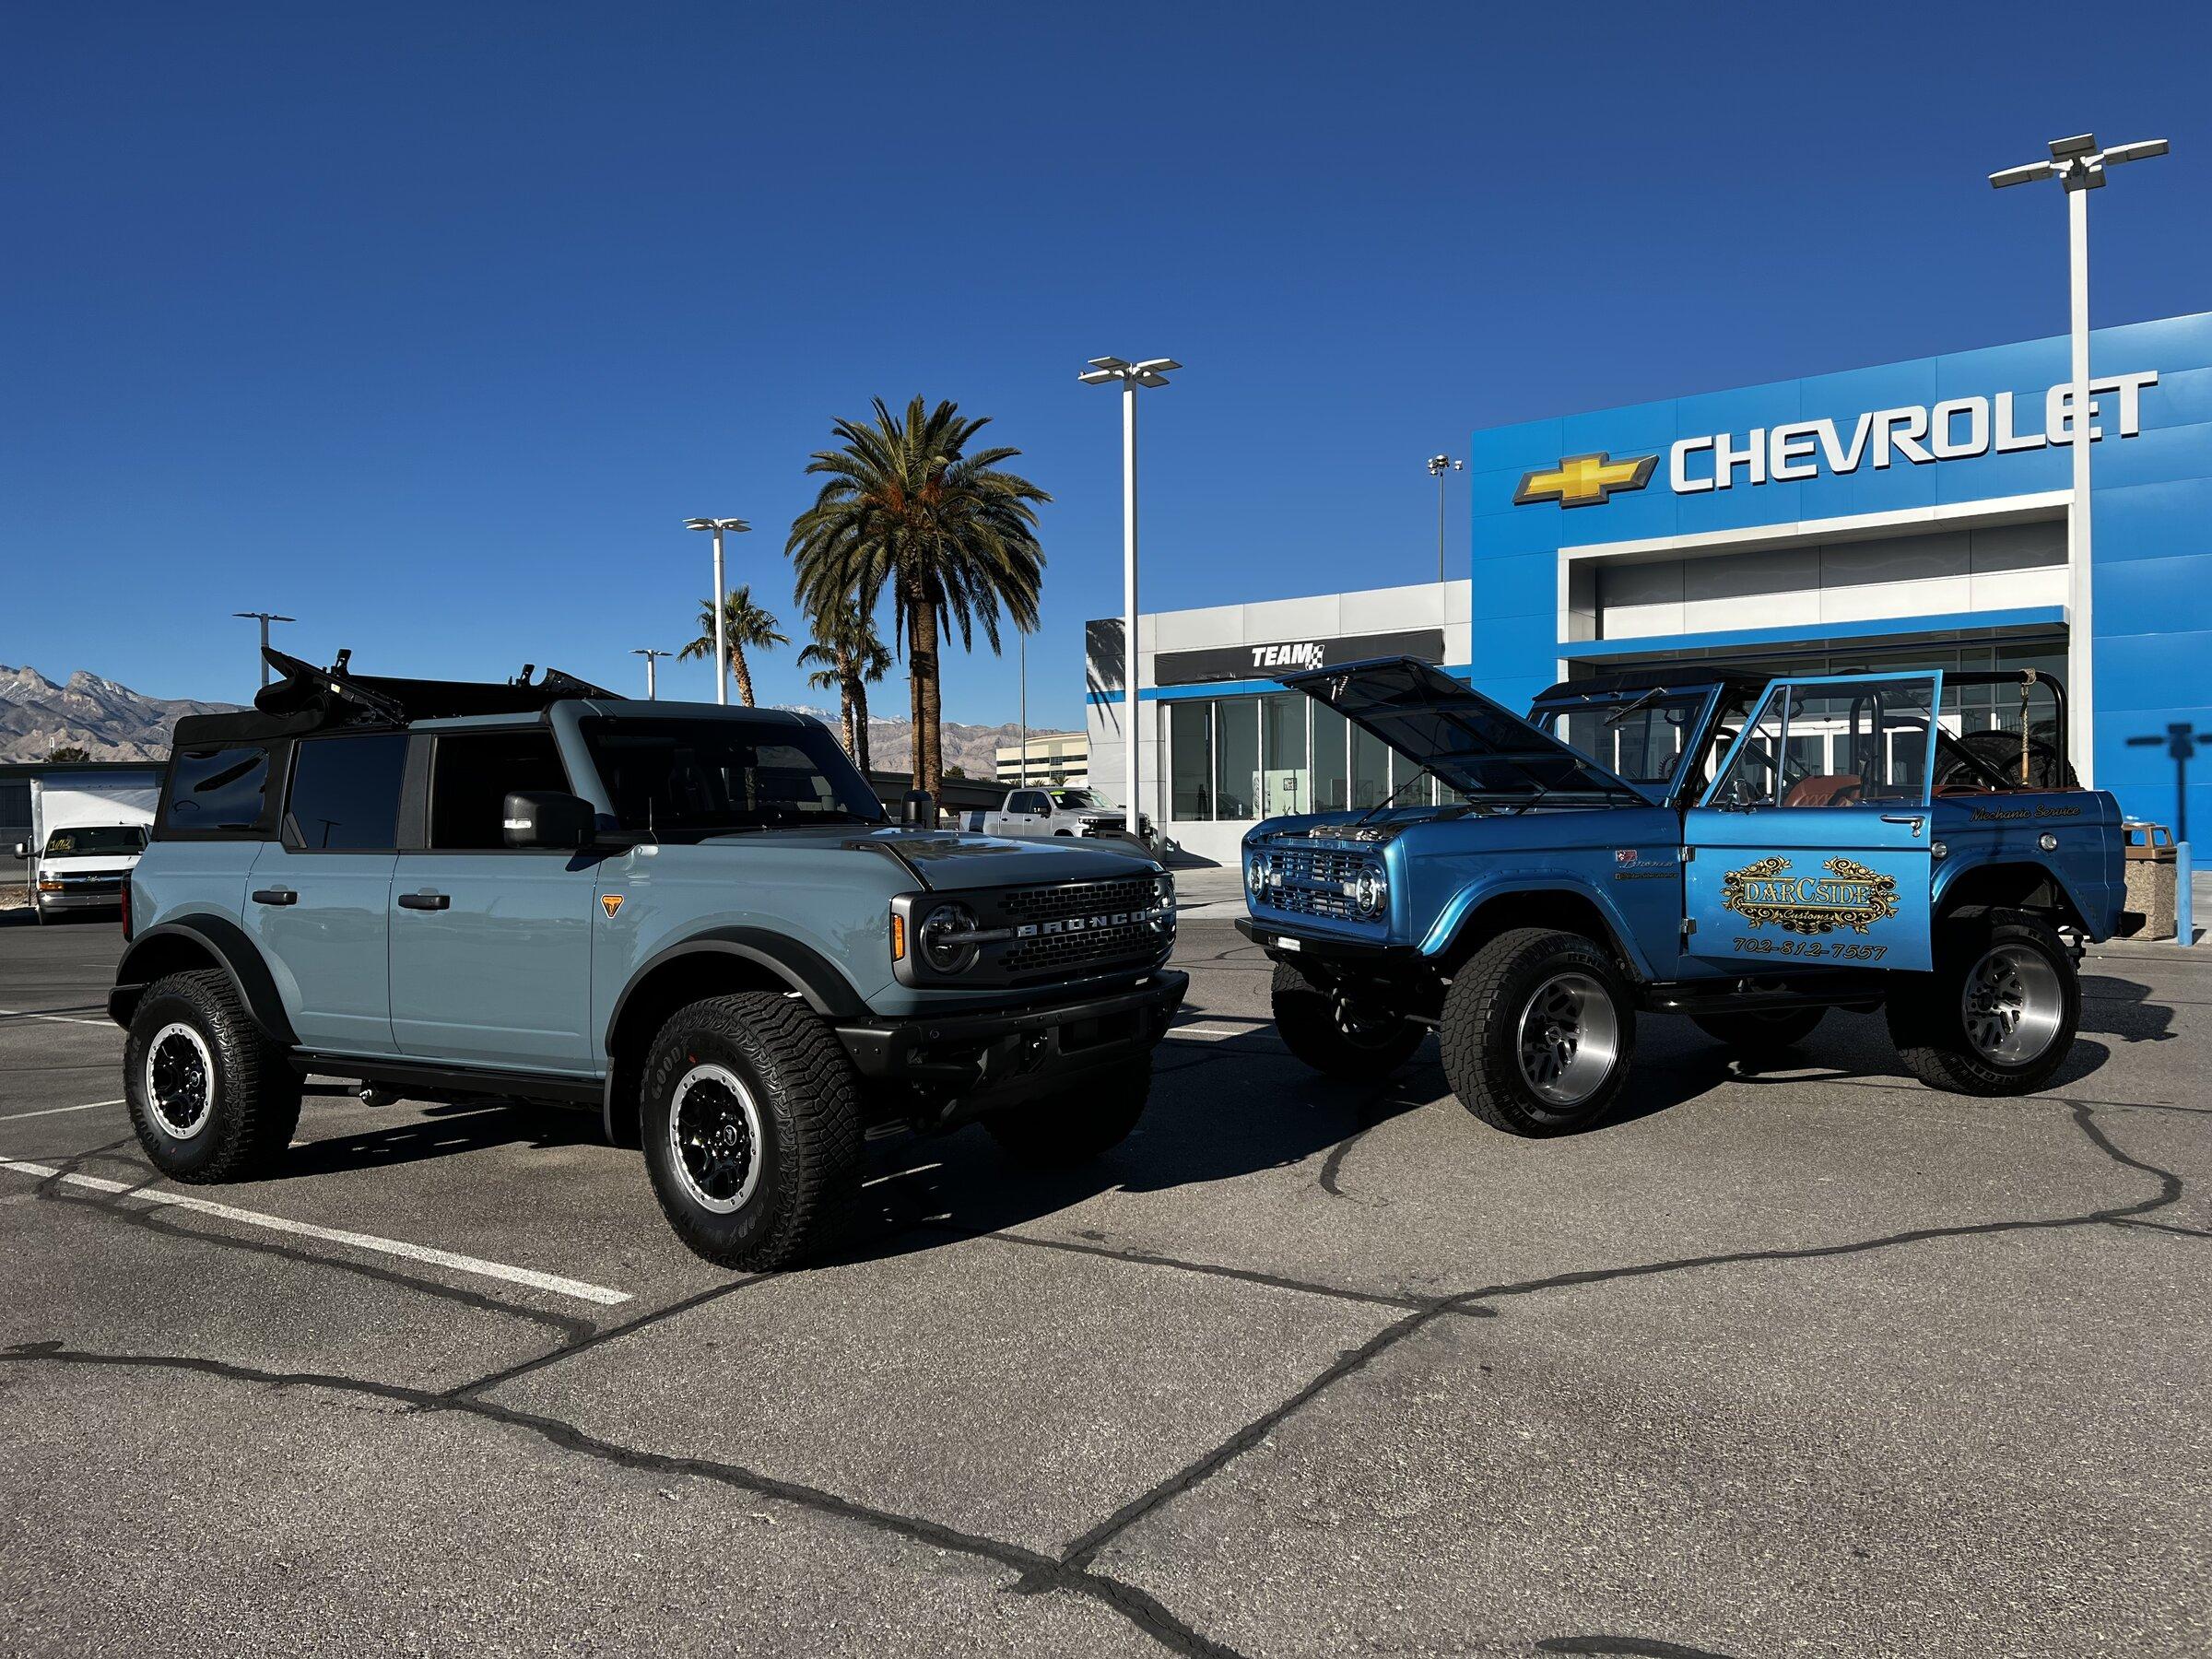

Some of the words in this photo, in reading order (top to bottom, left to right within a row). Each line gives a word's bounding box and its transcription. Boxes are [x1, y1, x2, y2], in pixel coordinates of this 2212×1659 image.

[1670, 370, 2159, 495] CHEVROLET
[1252, 643, 1313, 667] TEAM
[1969, 805, 2031, 822] Mechanic
[2033, 804, 2080, 818] Service
[1017, 911, 1147, 938] BRONCO
[1783, 909, 1830, 921] Customs
[1733, 936, 1888, 961] 702-812-7557
